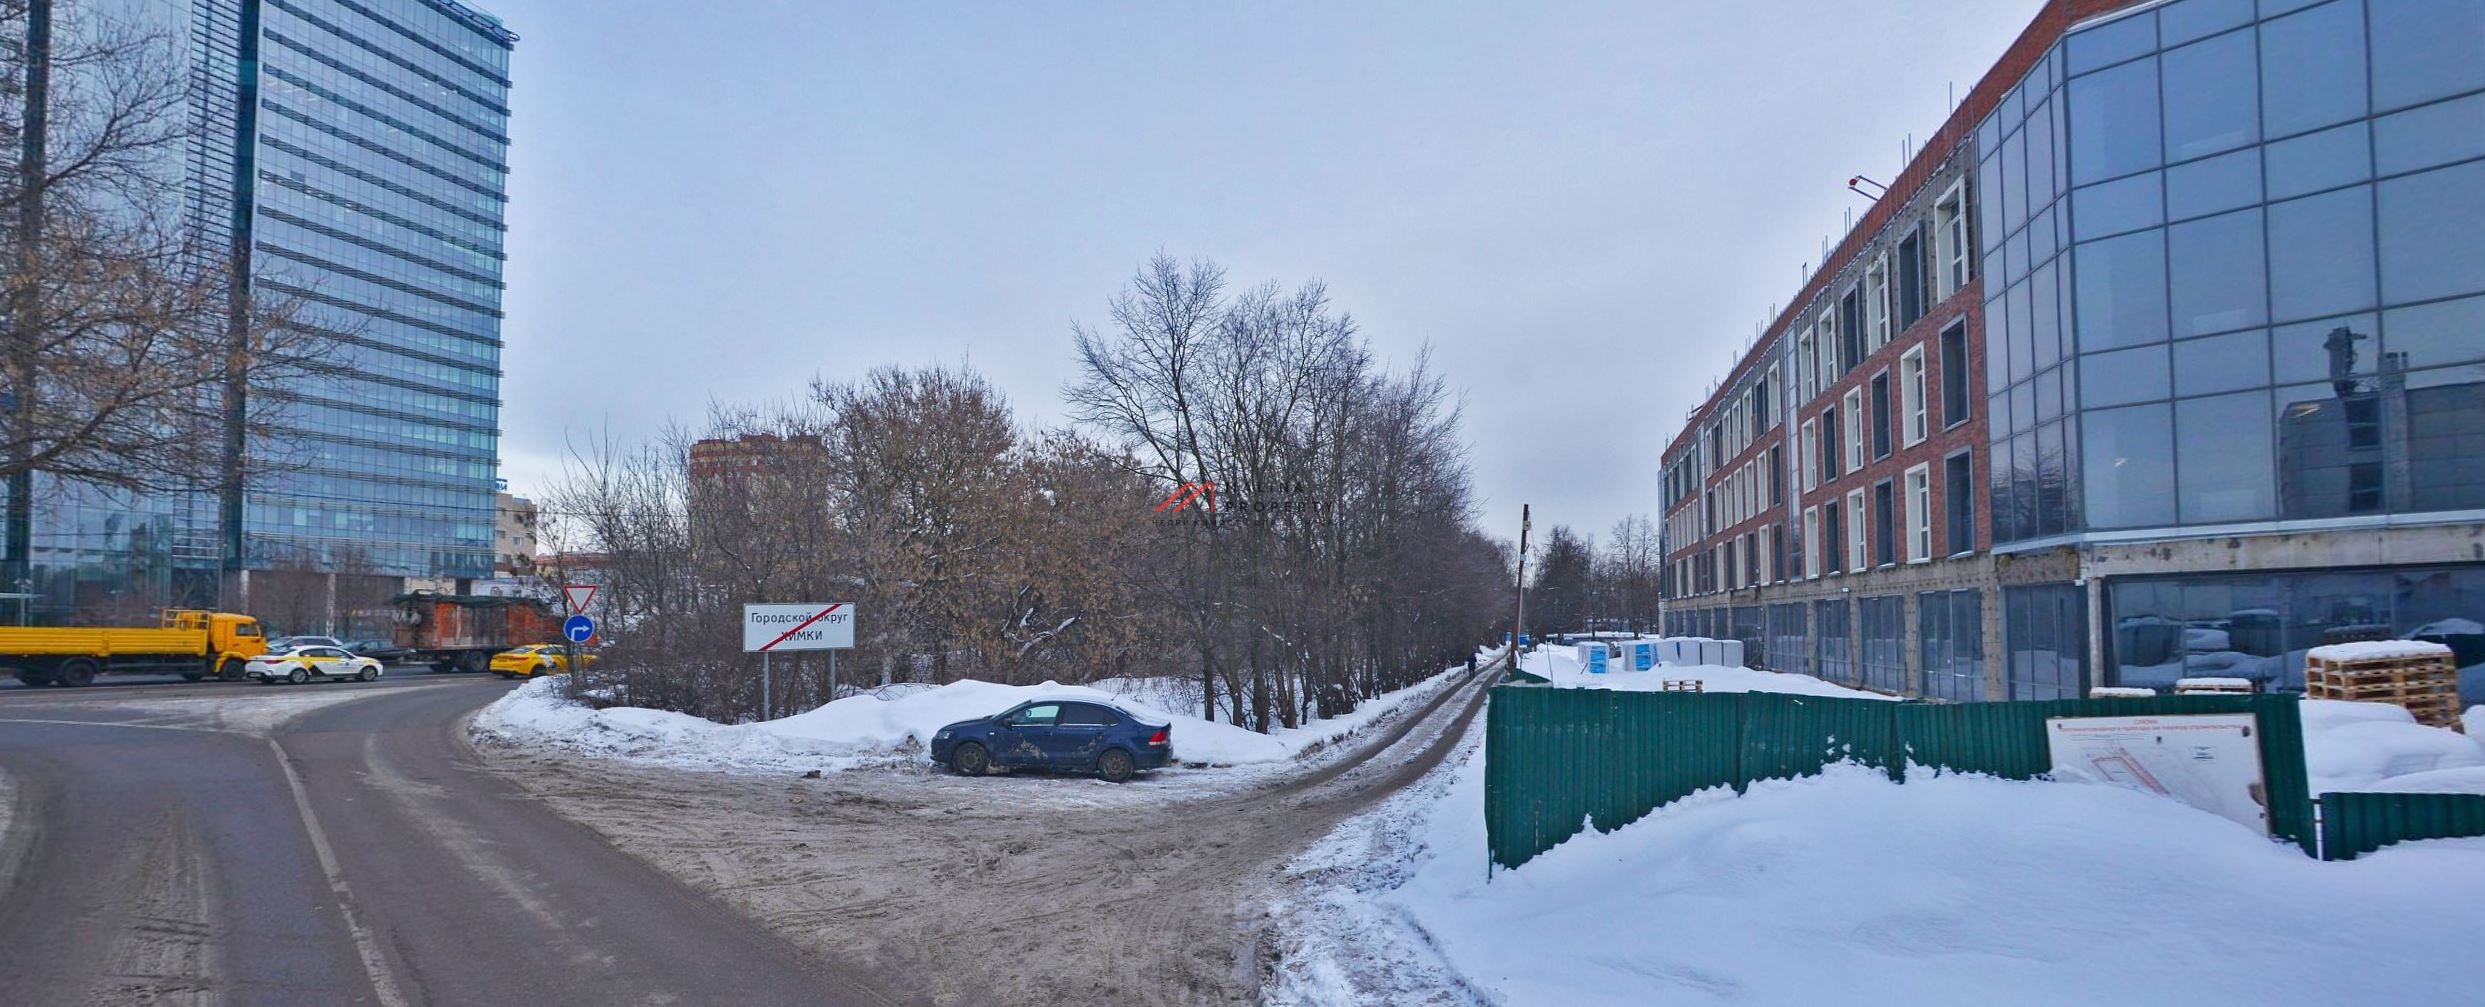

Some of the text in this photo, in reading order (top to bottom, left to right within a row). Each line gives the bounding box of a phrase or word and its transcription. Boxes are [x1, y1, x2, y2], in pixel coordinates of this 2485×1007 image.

[751, 612, 848, 625] Городской округ
[781, 631, 822, 641] ХИМКИ
